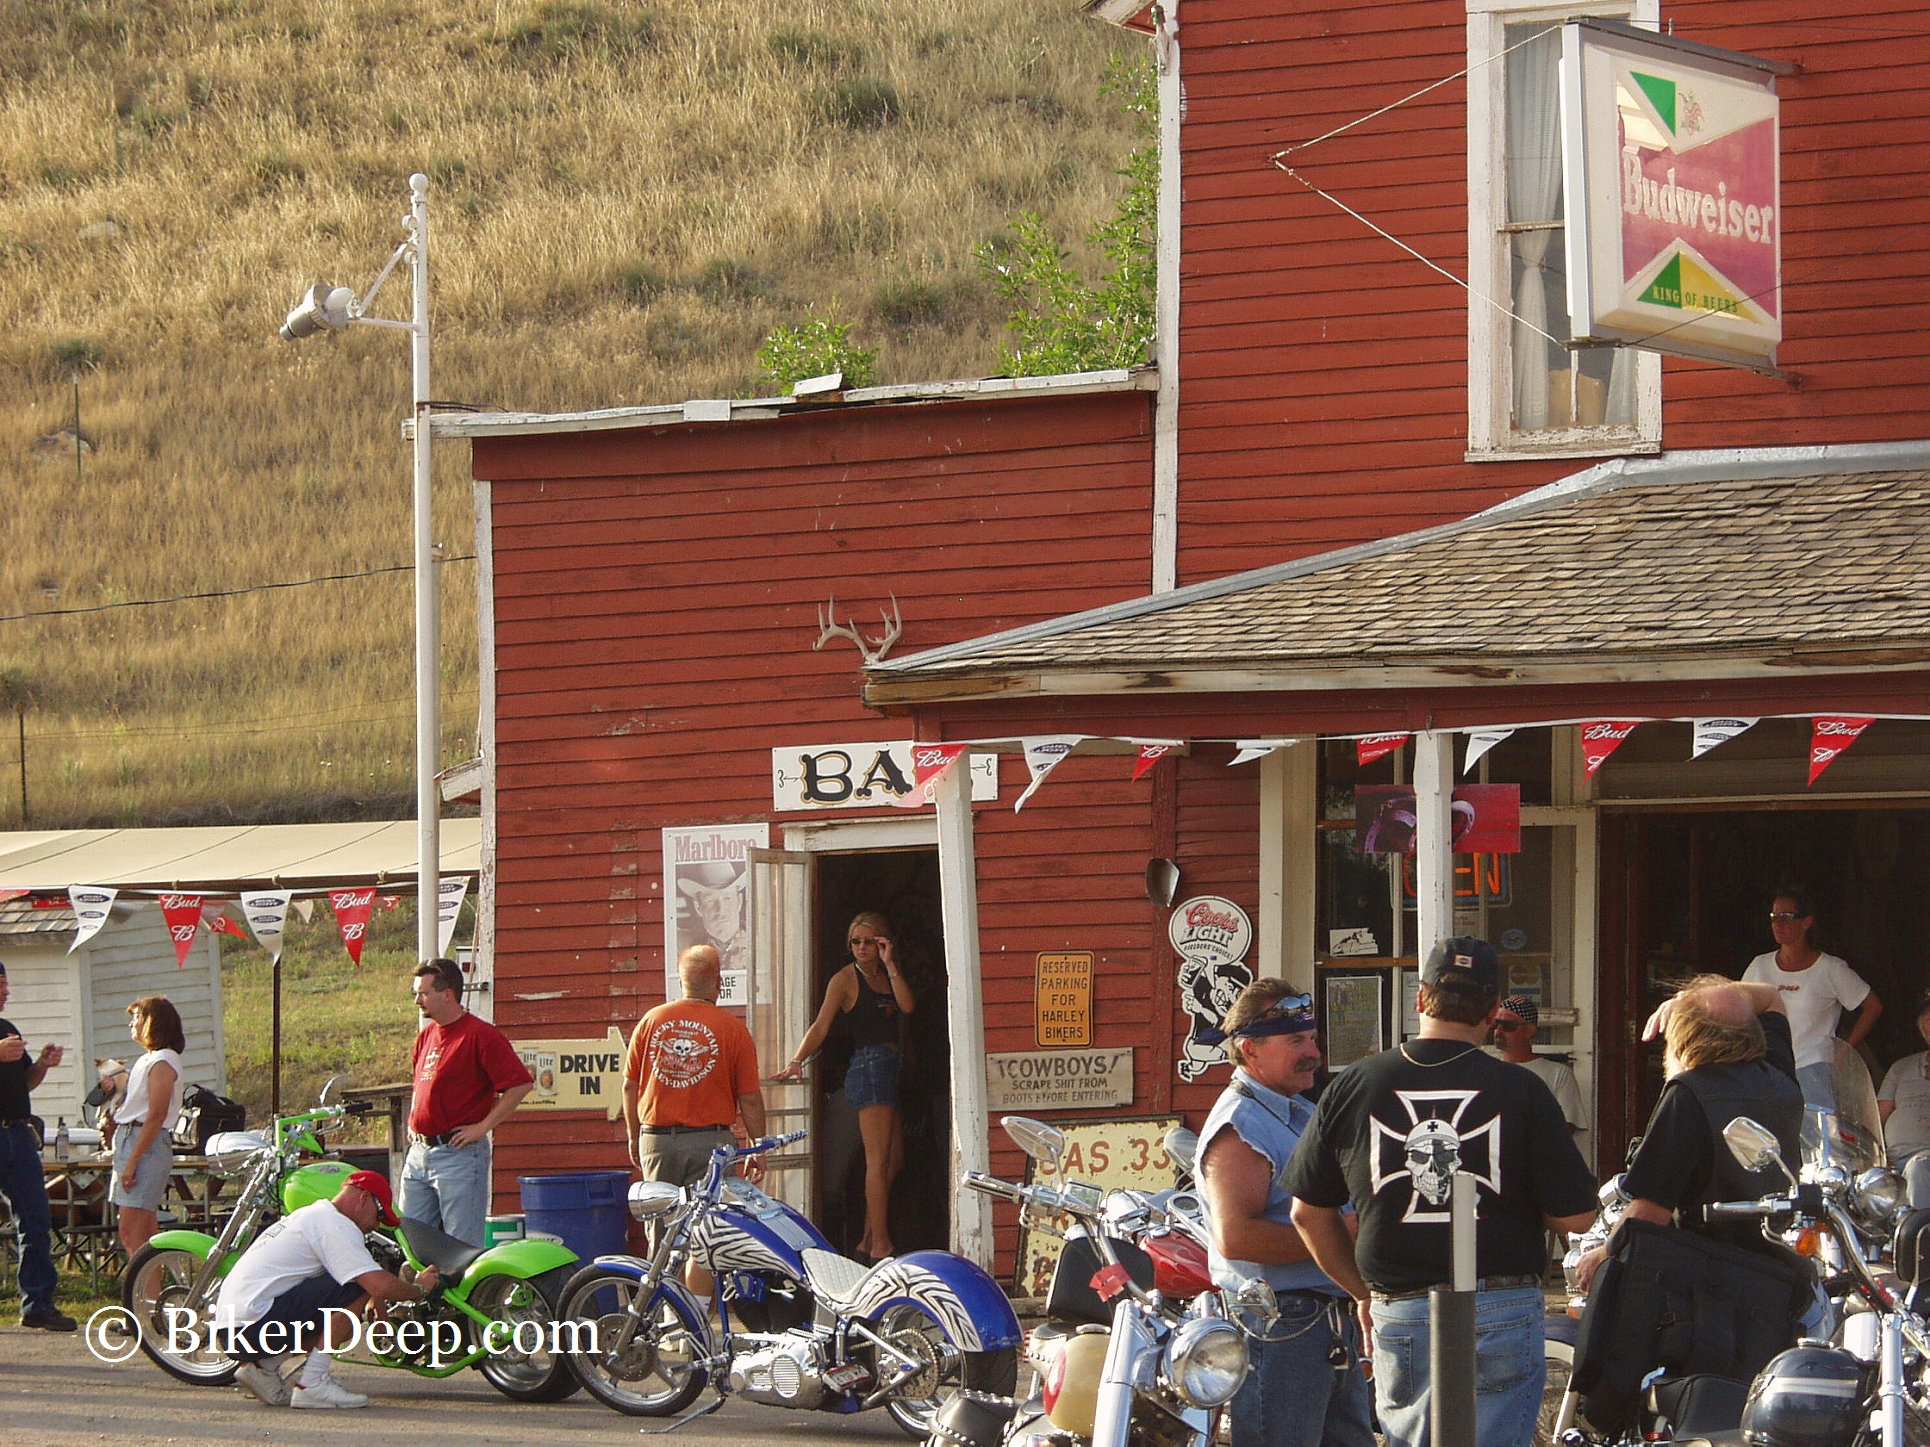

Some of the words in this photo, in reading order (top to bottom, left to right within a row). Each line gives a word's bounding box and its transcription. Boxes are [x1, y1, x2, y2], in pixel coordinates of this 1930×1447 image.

[1622, 148, 1773, 244] Budweiser
[1685, 292, 1697, 305] OF
[1584, 724, 1635, 740] Bud
[1817, 721, 1868, 737] Bud
[799, 749, 935, 805] BA
[161, 894, 201, 910] Bud
[333, 891, 373, 909] Bud
[1186, 902, 1239, 933] Coors
[1180, 925, 1234, 948] LIGHT
[1042, 961, 1088, 974] RESERVED
[1041, 977, 1088, 990] PARKING
[1051, 993, 1076, 1006] FOR
[1042, 1010, 1085, 1022] HARLEY
[679, 1019, 719, 1056] MOUNTAIN
[1045, 1026, 1083, 1039] BIKERS
[540, 1057, 554, 1068] Lite
[560, 1053, 620, 1074] DRIVE
[579, 1075, 601, 1095] IN
[1012, 1079, 1052, 1091] SCRAPE
[1055, 1078, 1076, 1090] SHIT
[1080, 1077, 1108, 1089] FROM
[1003, 1093, 1033, 1104] BOOTS
[1072, 1089, 1119, 1102] ENTERING
